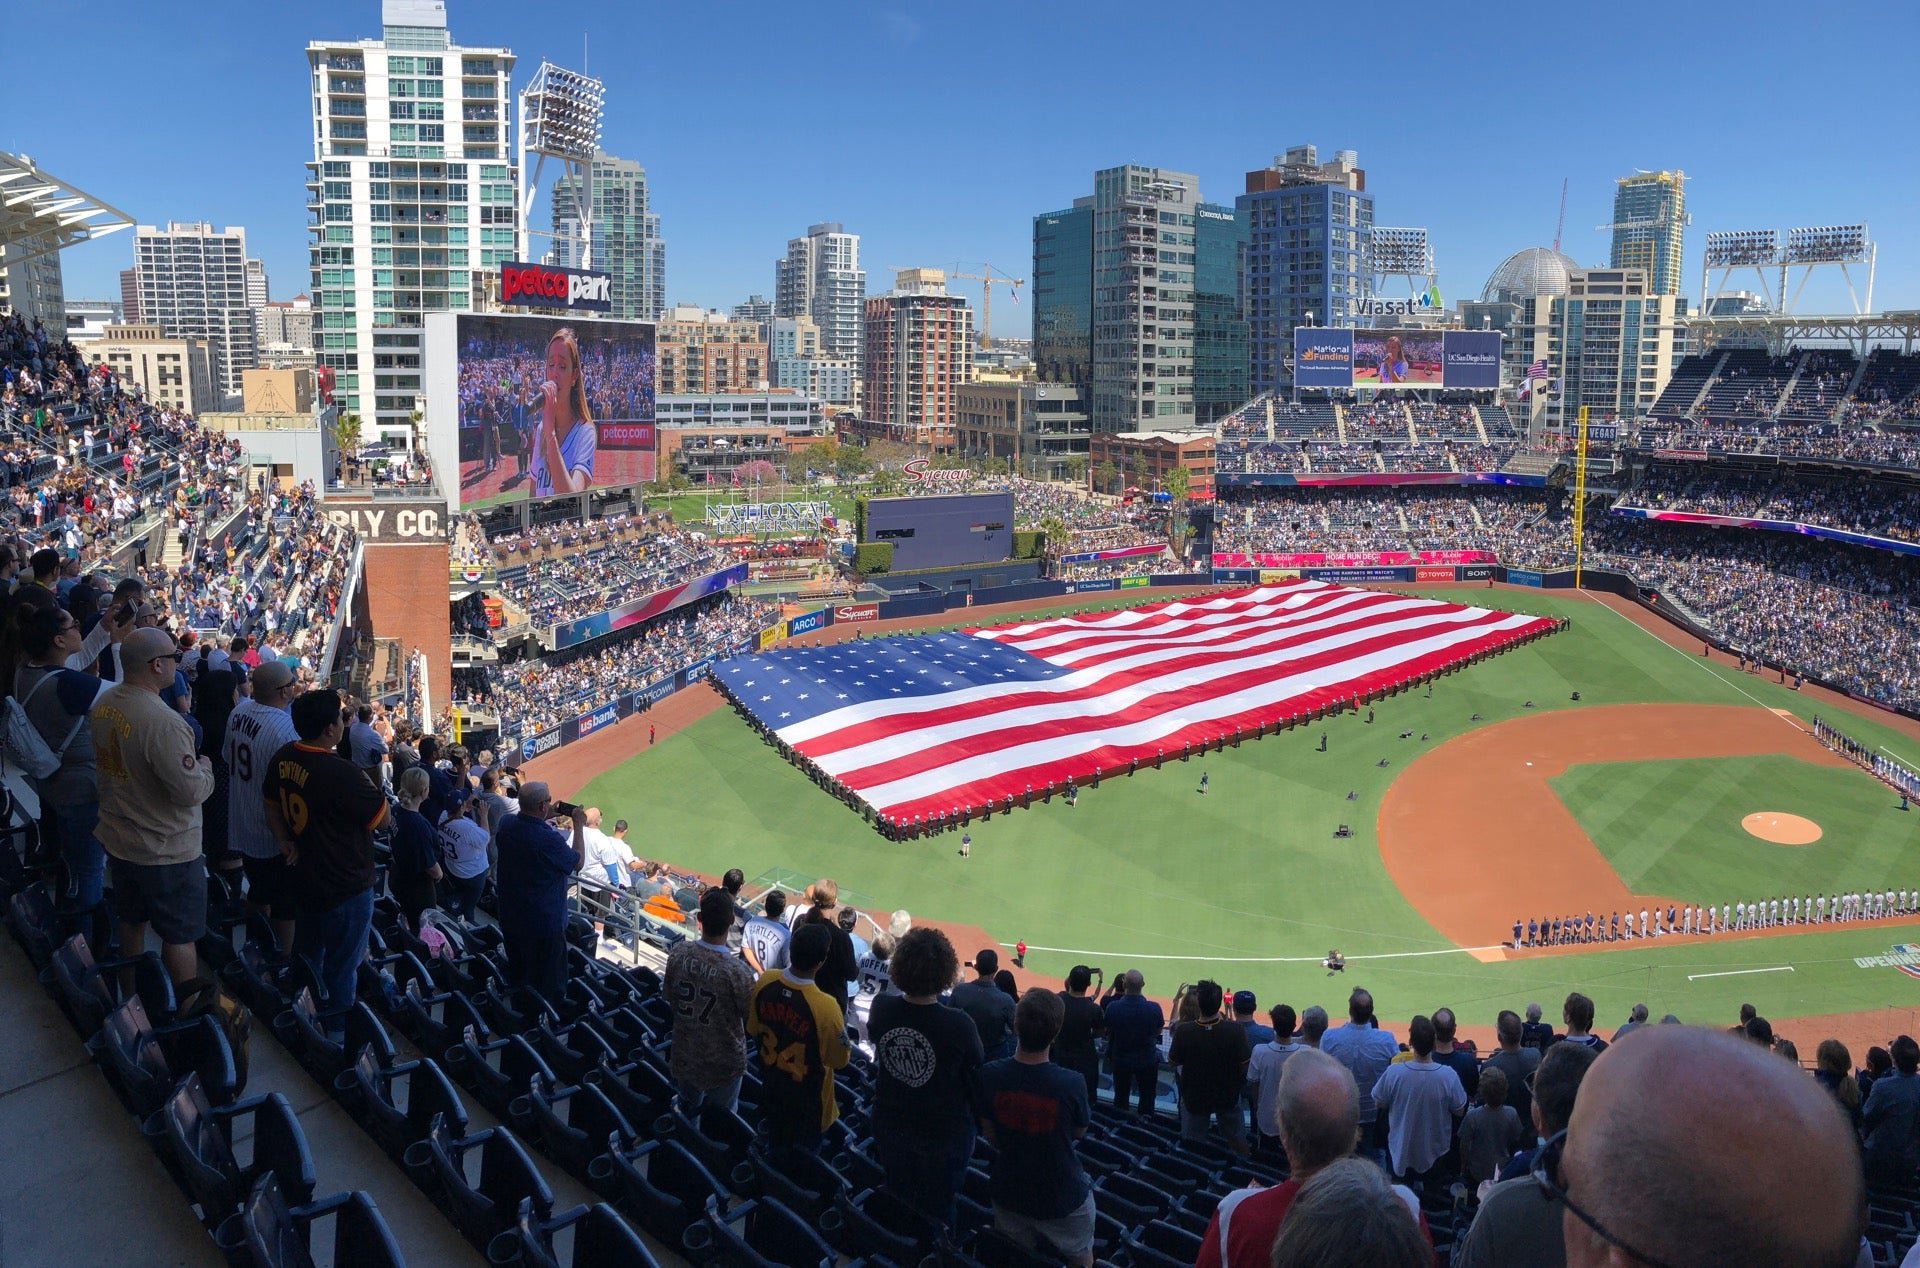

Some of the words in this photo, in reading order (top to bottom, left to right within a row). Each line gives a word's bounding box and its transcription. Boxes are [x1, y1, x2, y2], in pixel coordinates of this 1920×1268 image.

[1356, 298, 1416, 316] Viasat
[1314, 345, 1349, 353] National
[1314, 353, 1349, 362] Funding
[1466, 354, 1480, 363] Diego
[603, 427, 649, 440] petco.com
[1590, 428, 1615, 439] VEGAS
[903, 459, 971, 487] Sycuan
[706, 500, 827, 522] NATIONAL
[397, 510, 446, 537] CO.
[716, 520, 820, 535] UNIVERSITY
[1509, 572, 1540, 581] petco.com
[839, 606, 873, 620] Sycuan
[794, 617, 816, 631] ARCO
[232, 713, 261, 740] GWYNN
[537, 730, 559, 746] ROCKET
[537, 738, 559, 753] LEAGUE
[231, 739, 252, 781] 19
[279, 760, 309, 789] GWYNN
[280, 785, 308, 836] 19
[749, 925, 780, 945] BARTLETT
[757, 939, 766, 960] 8
[682, 956, 717, 980] KEMP
[861, 959, 888, 974] HOFFM
[678, 980, 717, 1026] 27
[759, 1024, 808, 1082] 34
[908, 1046, 927, 1062] THE
[889, 1057, 927, 1079] WALL
